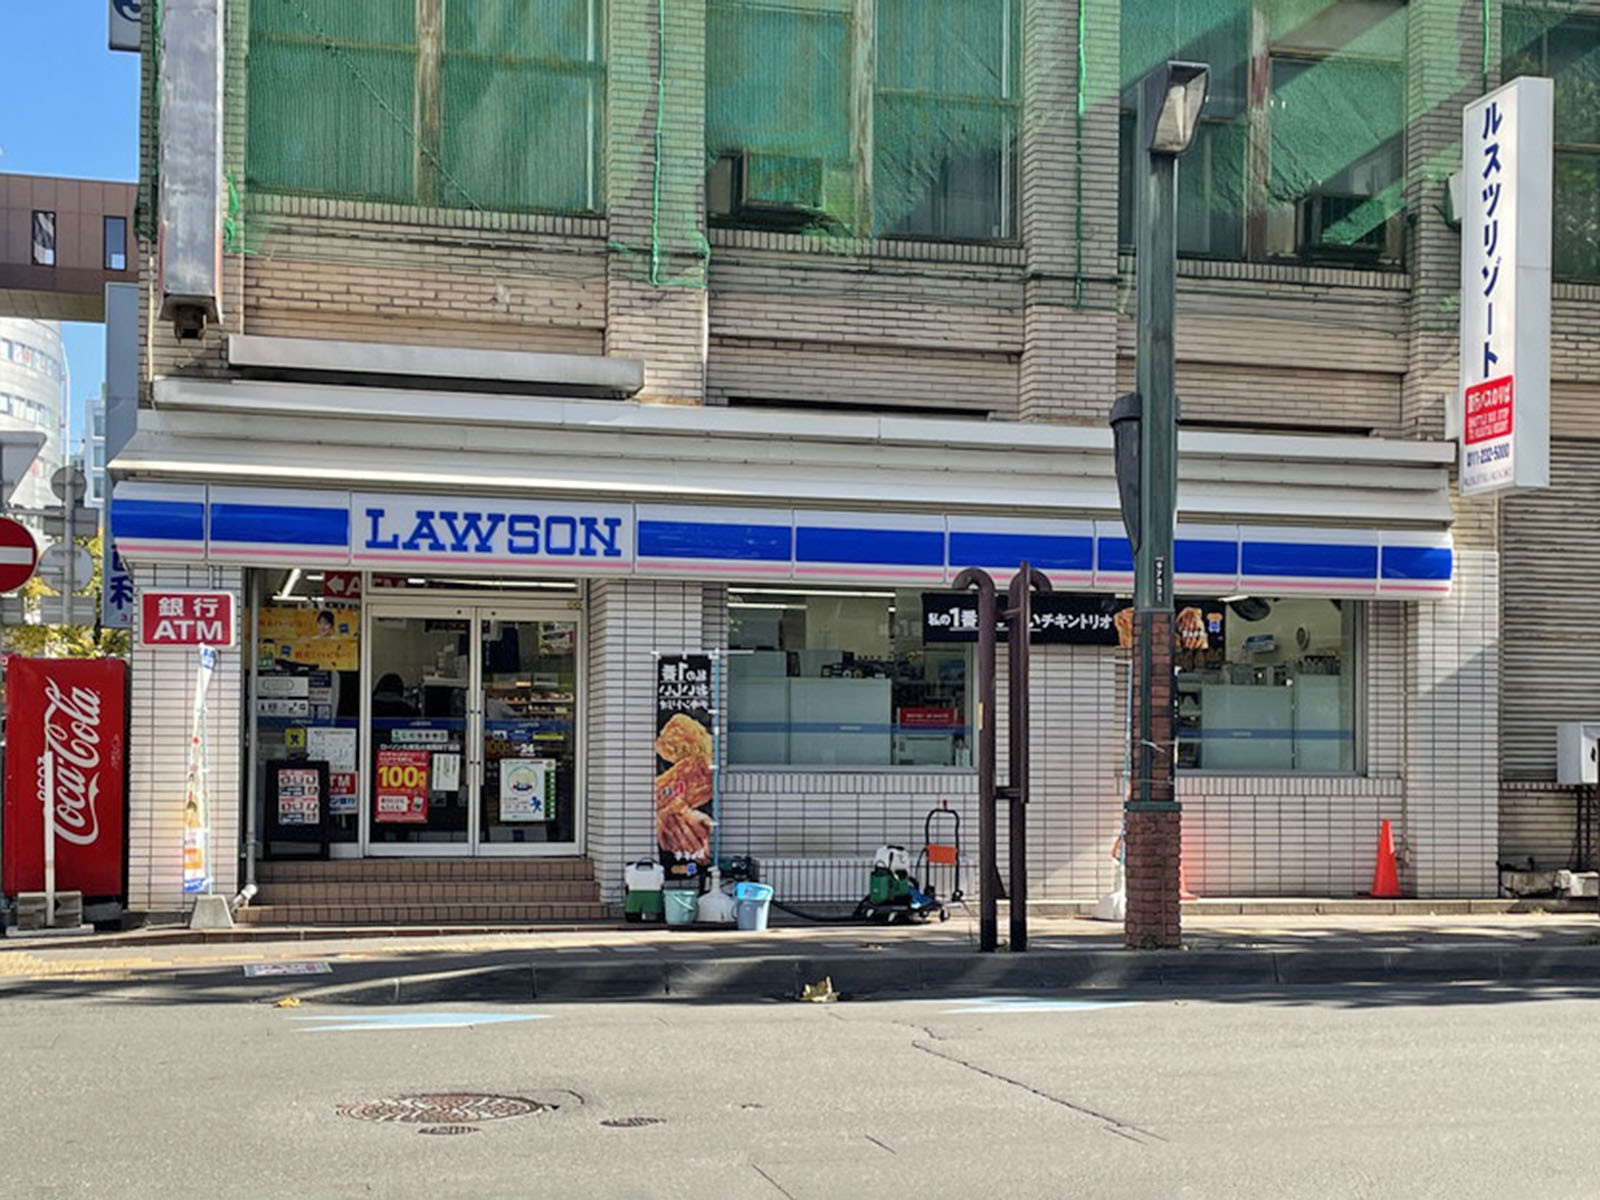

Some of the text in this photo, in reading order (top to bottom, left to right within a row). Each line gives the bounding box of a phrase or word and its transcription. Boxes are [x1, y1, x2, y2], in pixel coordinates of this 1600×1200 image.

[1482, 102, 1503, 378] ルスツリゾート
[365, 508, 622, 557] LAWSON
[153, 620, 223, 641] ATM
[158, 597, 219, 618] 銀行
[44, 677, 100, 845] Coca-Cola
